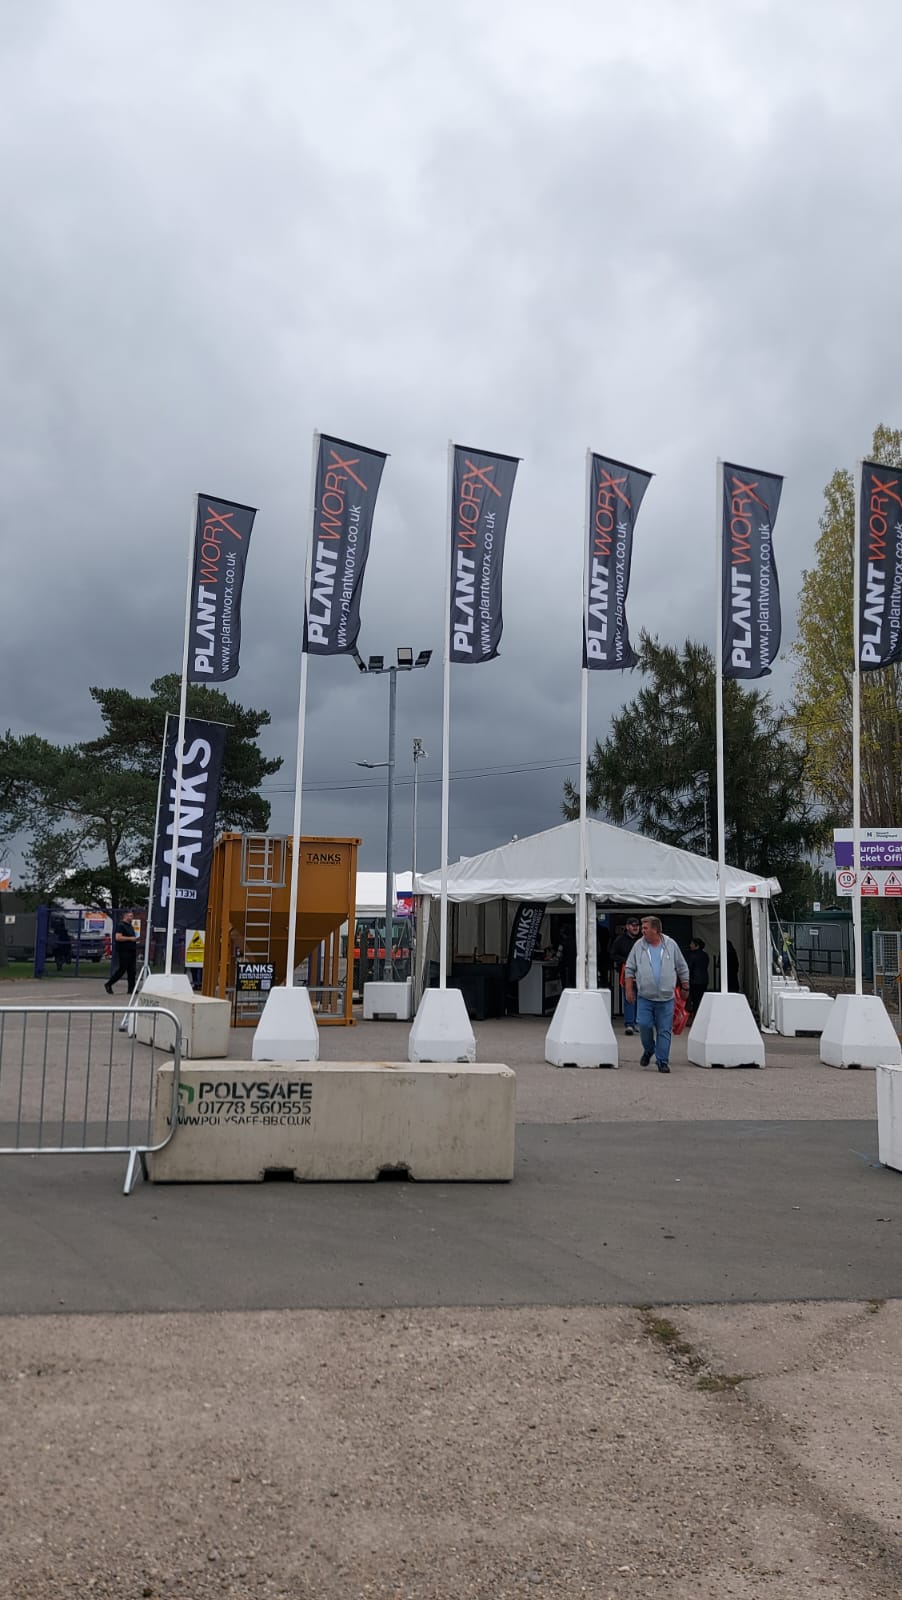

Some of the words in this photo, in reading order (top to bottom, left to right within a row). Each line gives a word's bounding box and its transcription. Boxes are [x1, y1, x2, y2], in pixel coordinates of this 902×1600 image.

[337, 504, 361, 647] www.plantworx.co.uk
[480, 511, 496, 654] www.plantworx.co.uk
[614, 521, 628, 662] www.plantworx.co.uk
[756, 523, 771, 669] www.plantworx.co.uk
[221, 551, 237, 674] www.plantworx.co.uk
[161, 737, 213, 908] TANKS
[306, 853, 342, 862] TANKS
[852, 854, 881, 862] cket
[860, 845, 885, 854] urple
[513, 907, 535, 960] TANKS
[238, 964, 274, 973] TANKS
[197, 1101, 246, 1115] 01778
[250, 1101, 312, 1115] 560555
[199, 1081, 313, 1099] POLYSAFE
